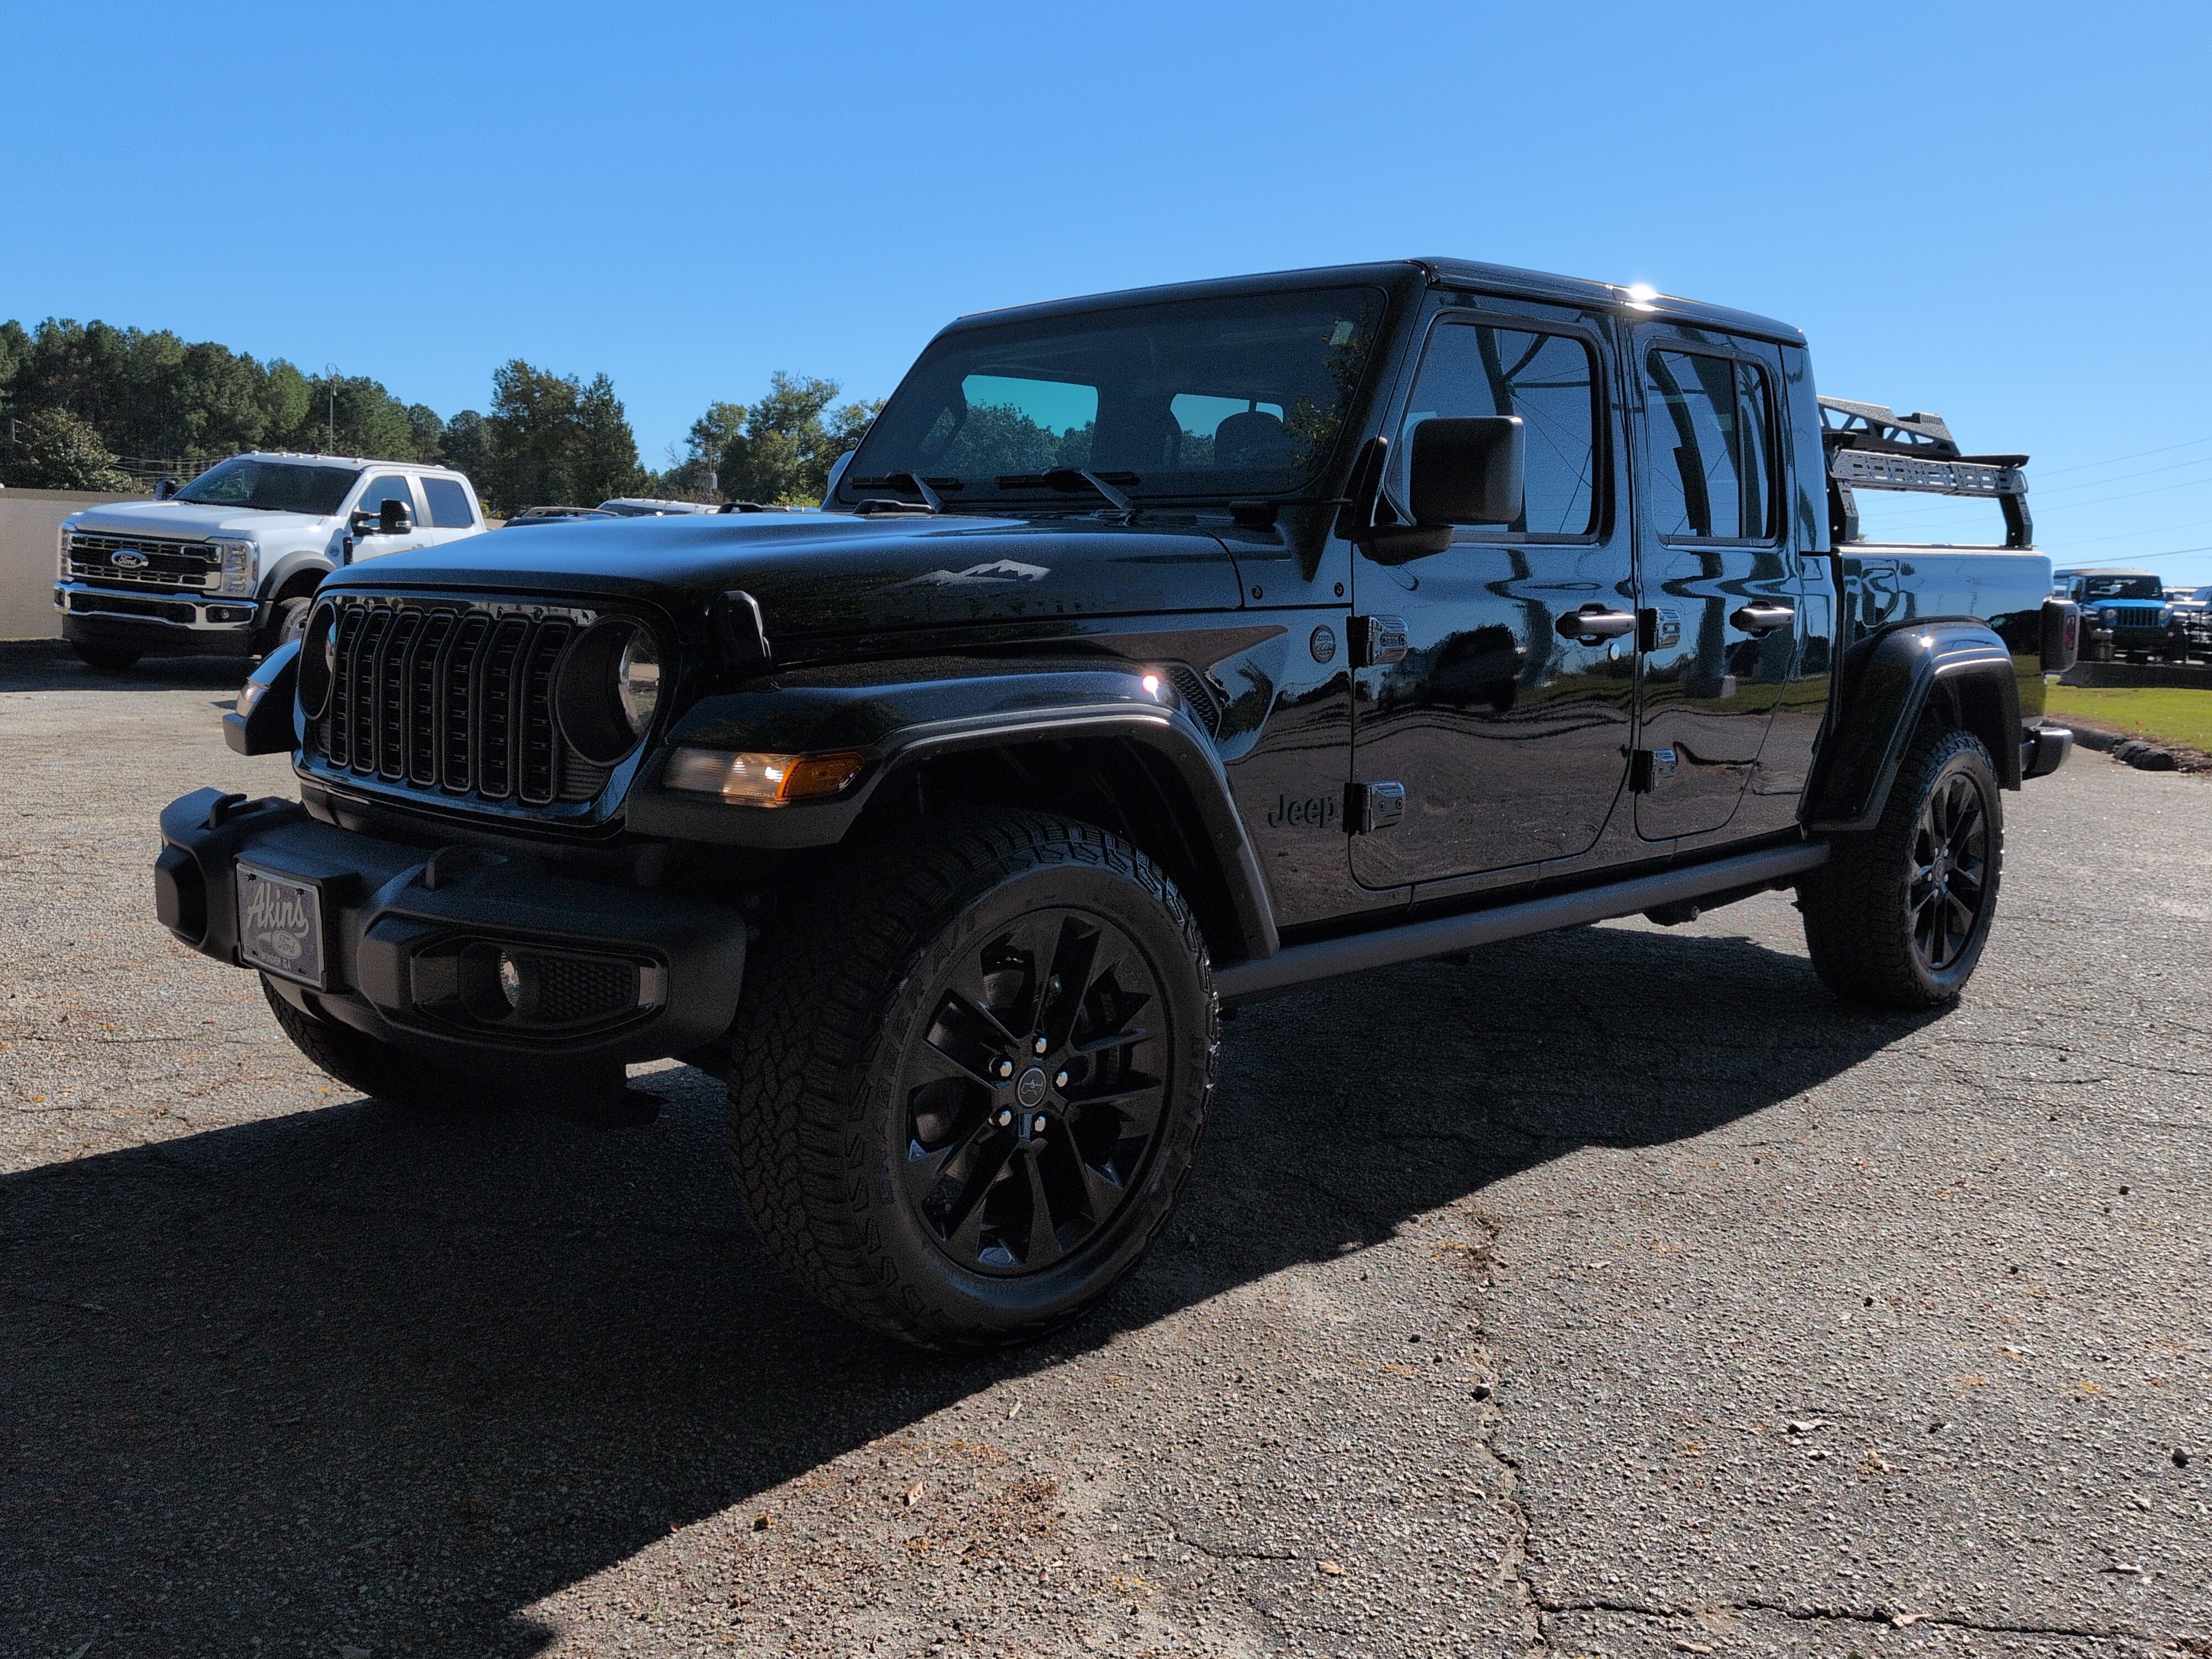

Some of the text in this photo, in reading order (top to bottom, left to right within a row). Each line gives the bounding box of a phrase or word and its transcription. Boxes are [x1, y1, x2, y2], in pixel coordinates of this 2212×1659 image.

[118, 554, 137, 565] Ford
[1268, 795, 1339, 828] Jeep
[246, 881, 309, 930] Akins
[279, 934, 295, 954] Ford
